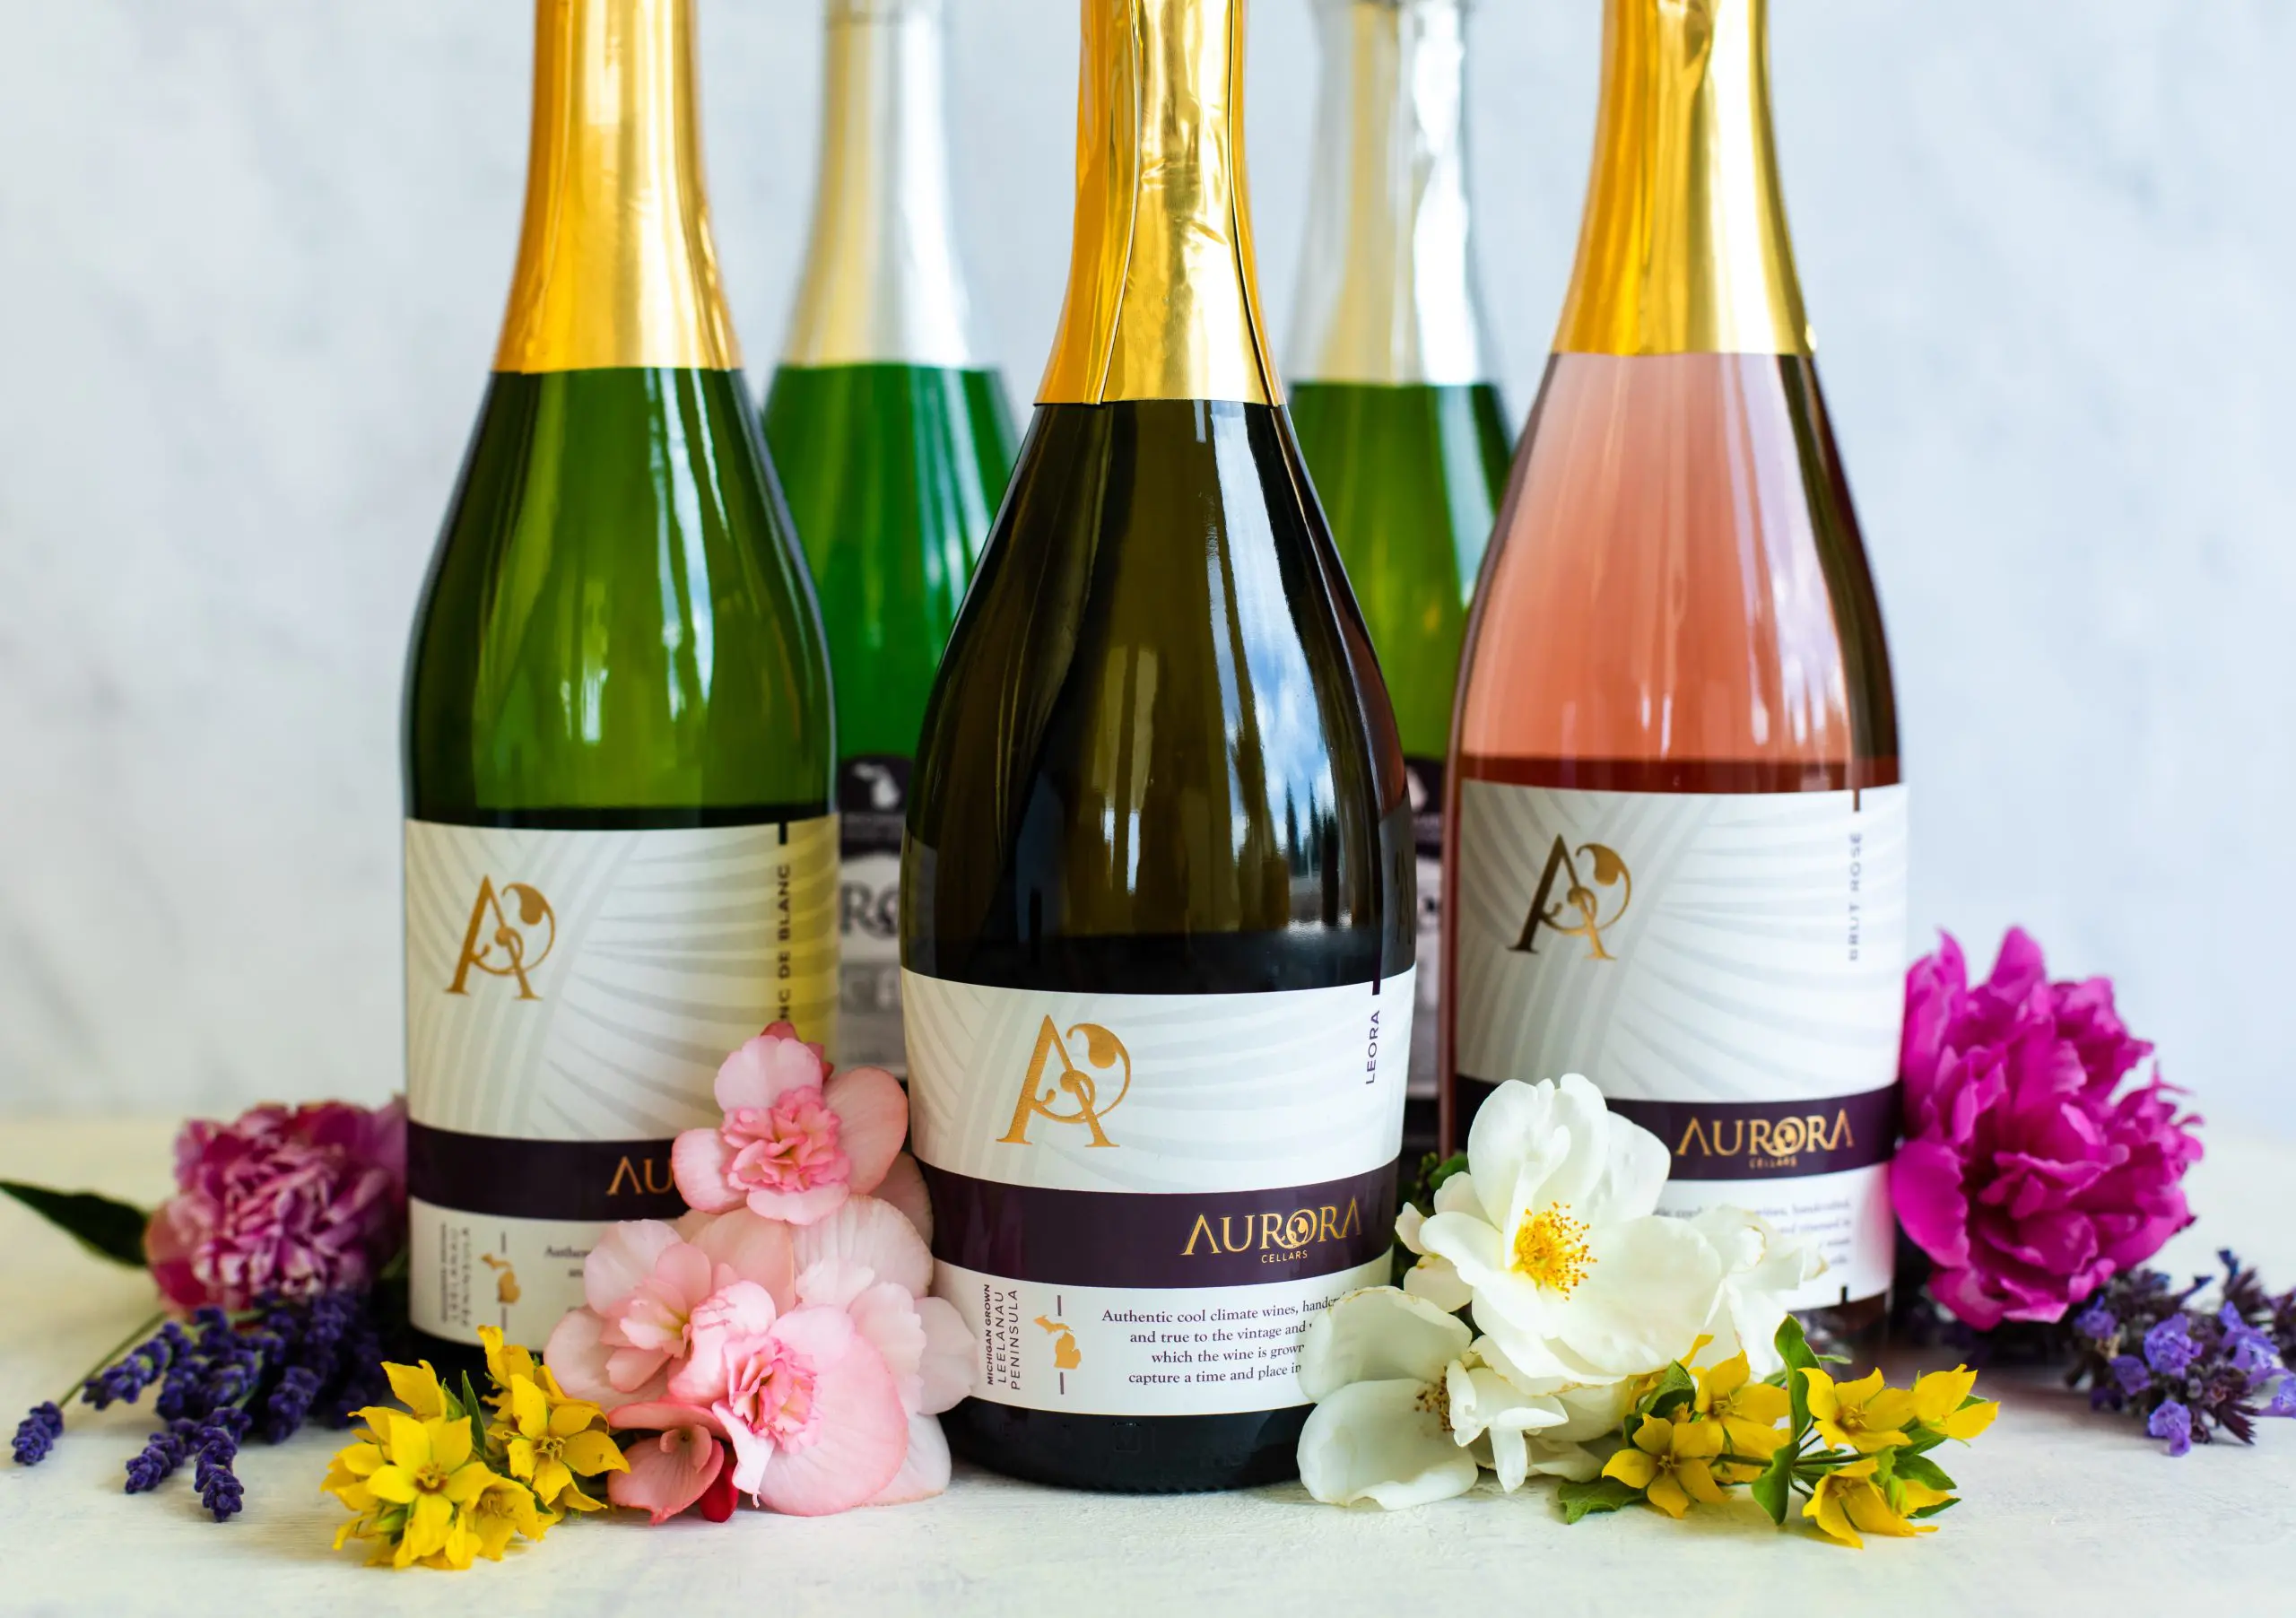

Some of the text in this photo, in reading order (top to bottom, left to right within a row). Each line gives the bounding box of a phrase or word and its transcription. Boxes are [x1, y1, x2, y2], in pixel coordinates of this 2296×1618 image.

[777, 865, 791, 1022] NC DE BLANC
[1366, 1009, 1379, 1084] LEORA
[1674, 1108, 1855, 1158] AURORA
[605, 1155, 674, 1196] AU
[1180, 1195, 1362, 1256] AURORA
[1261, 1250, 1308, 1264] CELLARS
[984, 1283, 994, 1386] MICHIGAN GROWN
[994, 1292, 1006, 1383] LEELANAU
[1101, 1309, 1173, 1323] Authentic
[1177, 1309, 1206, 1323] cool
[1210, 1308, 1258, 1321] climate
[1262, 1304, 1299, 1318] wines,
[1129, 1331, 1156, 1343] and
[1161, 1334, 1190, 1343] true
[1194, 1333, 1208, 1343] to
[1212, 1328, 1233, 1342] the
[1237, 1327, 1283, 1342] vintage
[1284, 1320, 1307, 1335] and
[1007, 1290, 1021, 1390] PENINSULA
[1152, 1350, 1193, 1363] which
[1197, 1349, 1220, 1362] the
[1223, 1348, 1255, 1361] wine
[1257, 1346, 1267, 1359] is
[1128, 1373, 1180, 1386] capture
[1184, 1374, 1192, 1383] a
[1196, 1370, 1227, 1383] time
[1230, 1367, 1254, 1381] and
[1257, 1364, 1289, 1381] place
